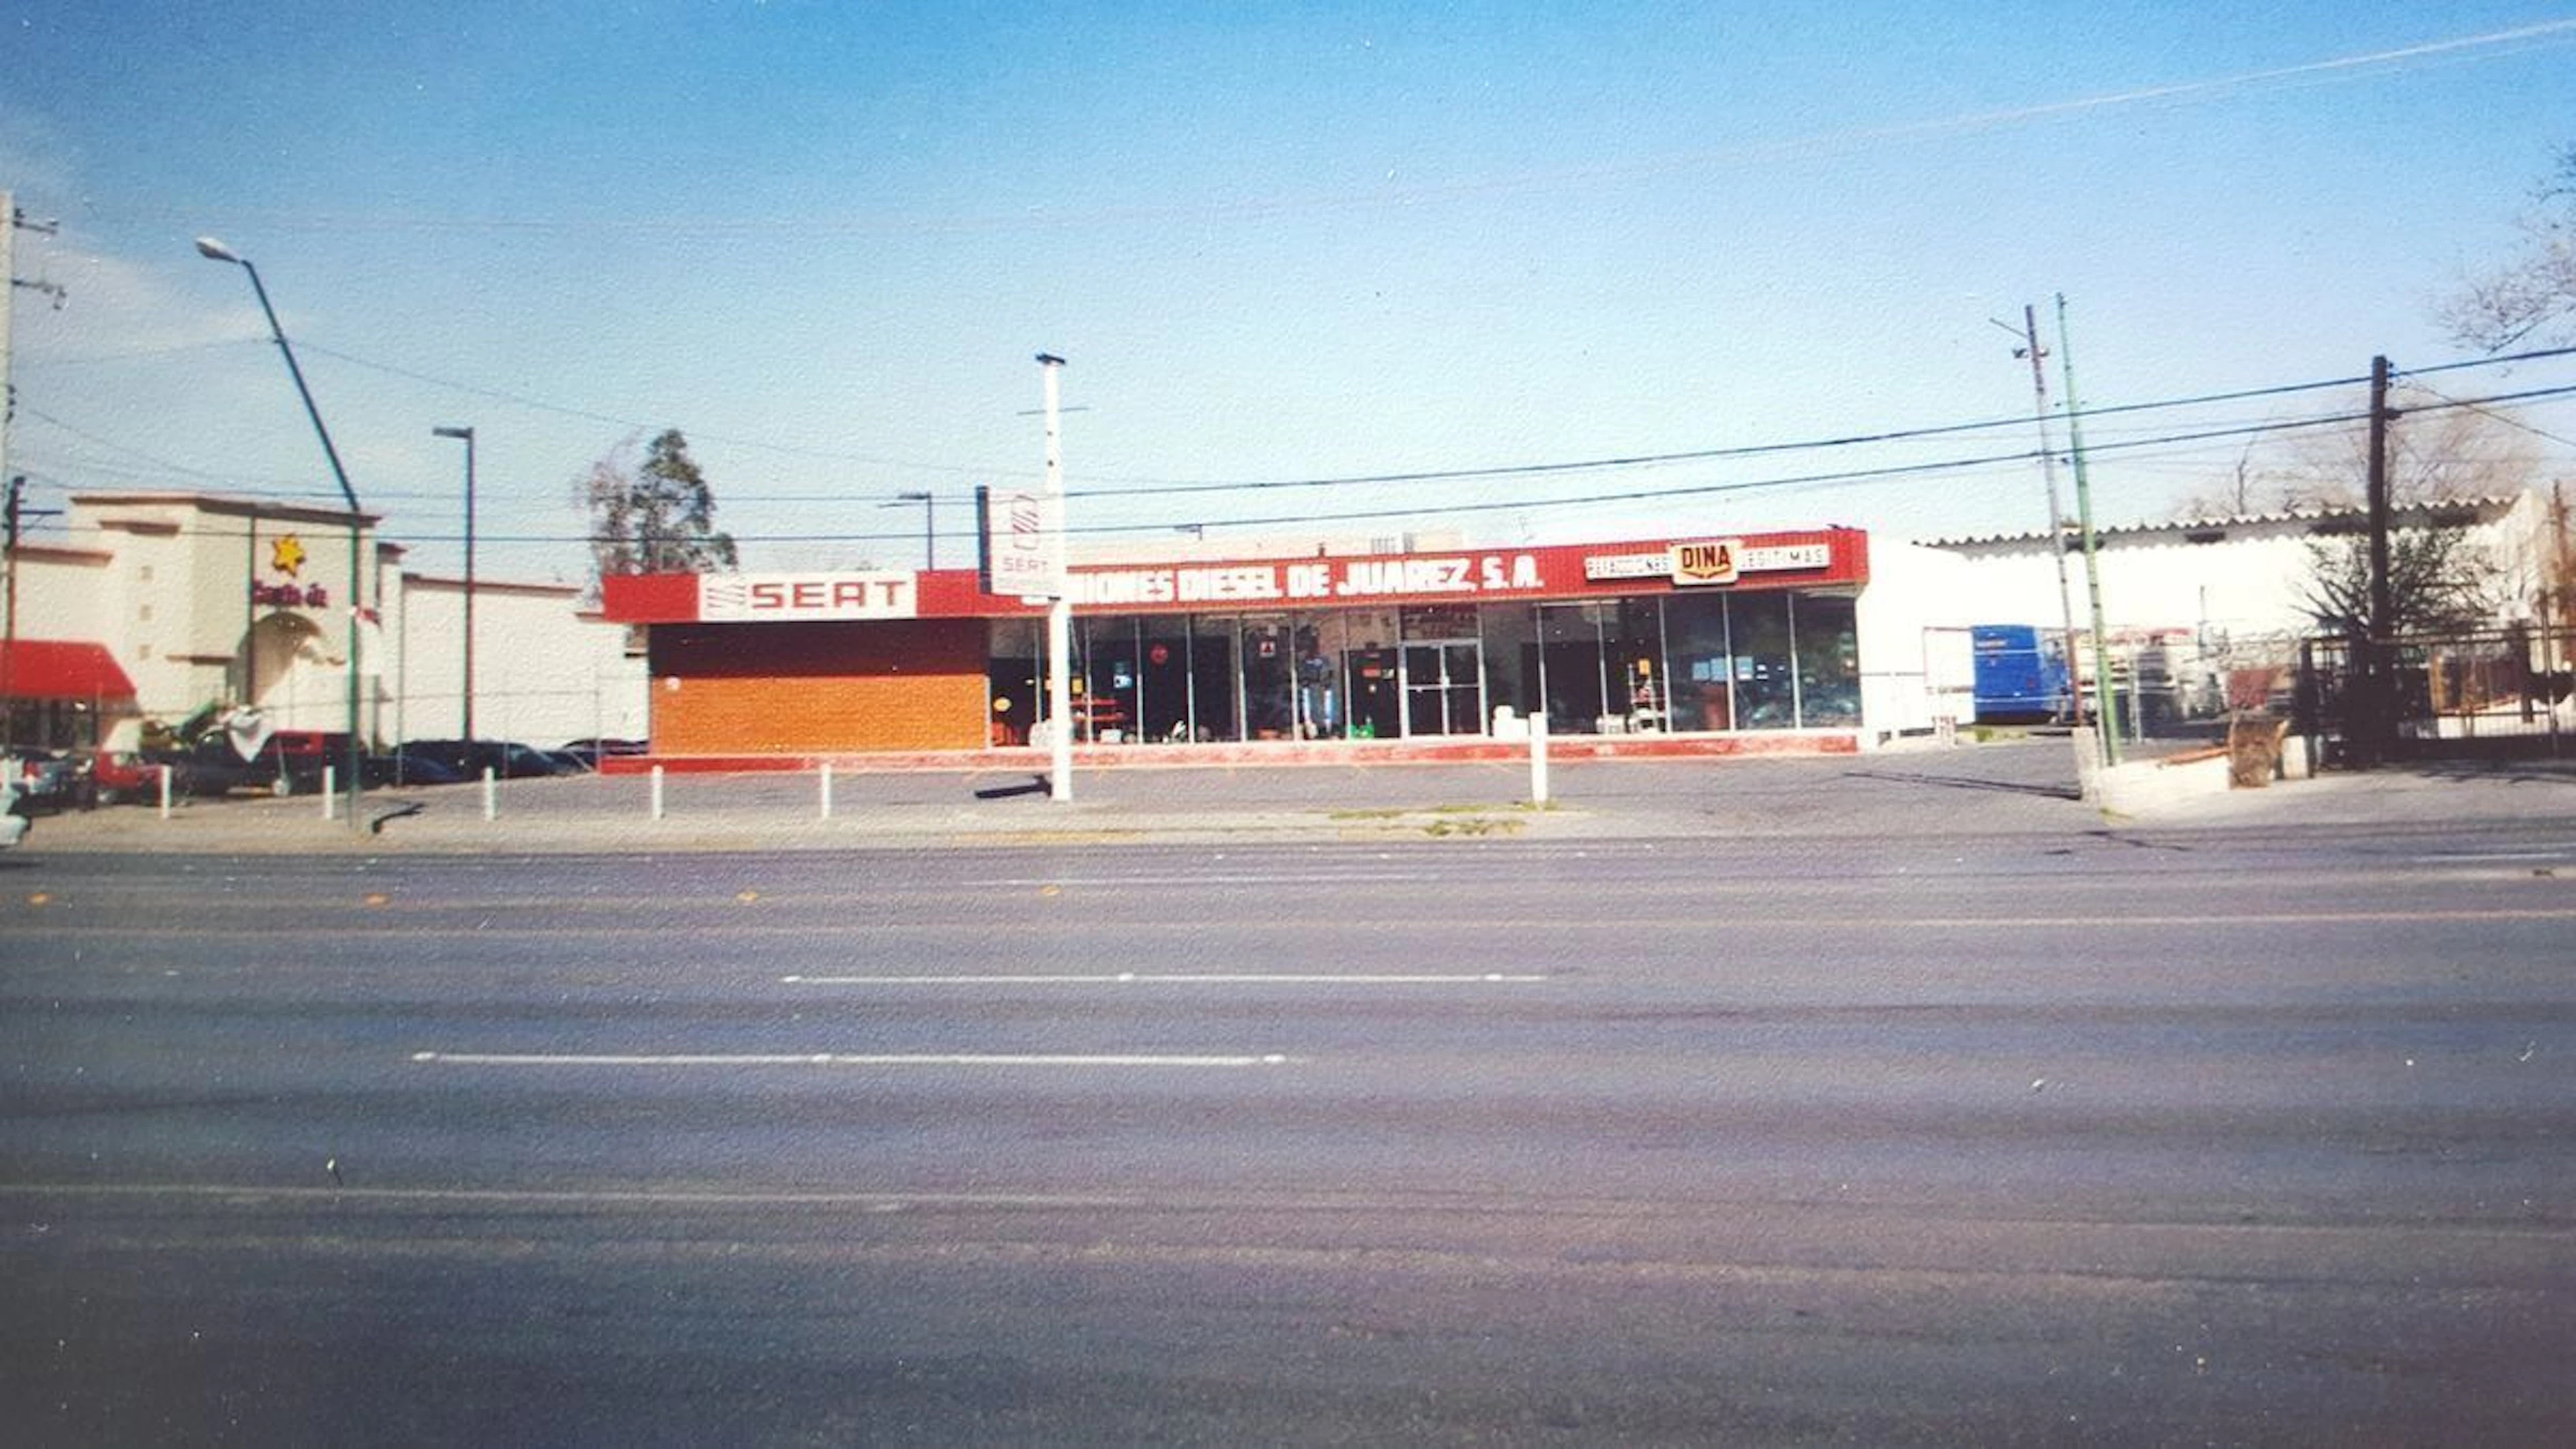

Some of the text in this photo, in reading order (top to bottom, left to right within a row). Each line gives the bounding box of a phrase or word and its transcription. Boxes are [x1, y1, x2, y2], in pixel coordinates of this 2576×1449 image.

[1004, 557, 1049, 572] SEAT
[1682, 545, 1730, 569] DINA
[752, 582, 906, 608] SEAT
[1177, 566, 1283, 602] DIESEL
[1287, 564, 1330, 598] DE
